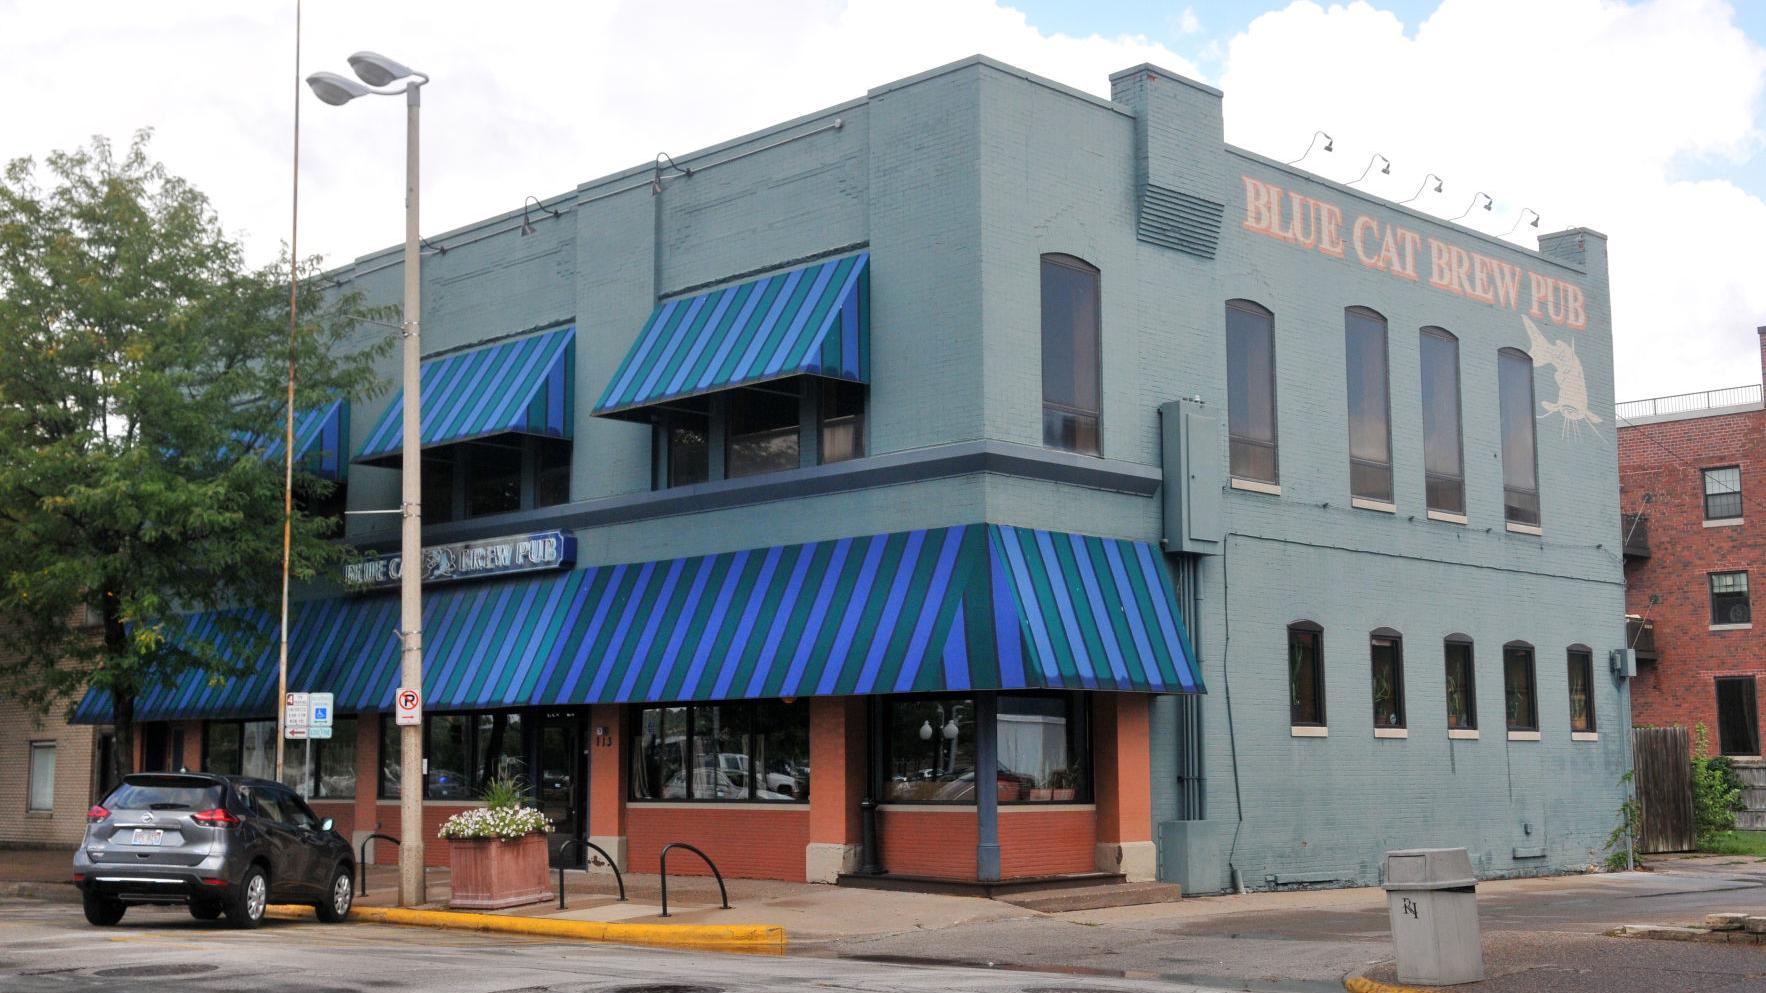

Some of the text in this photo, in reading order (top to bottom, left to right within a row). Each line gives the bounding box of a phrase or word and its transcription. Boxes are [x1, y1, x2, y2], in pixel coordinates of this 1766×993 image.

[1242, 176, 1588, 330] BLUE CAT BREW PUB
[459, 544, 513, 572] BREW
[516, 538, 557, 564] PUB
[596, 736, 612, 747] 113
